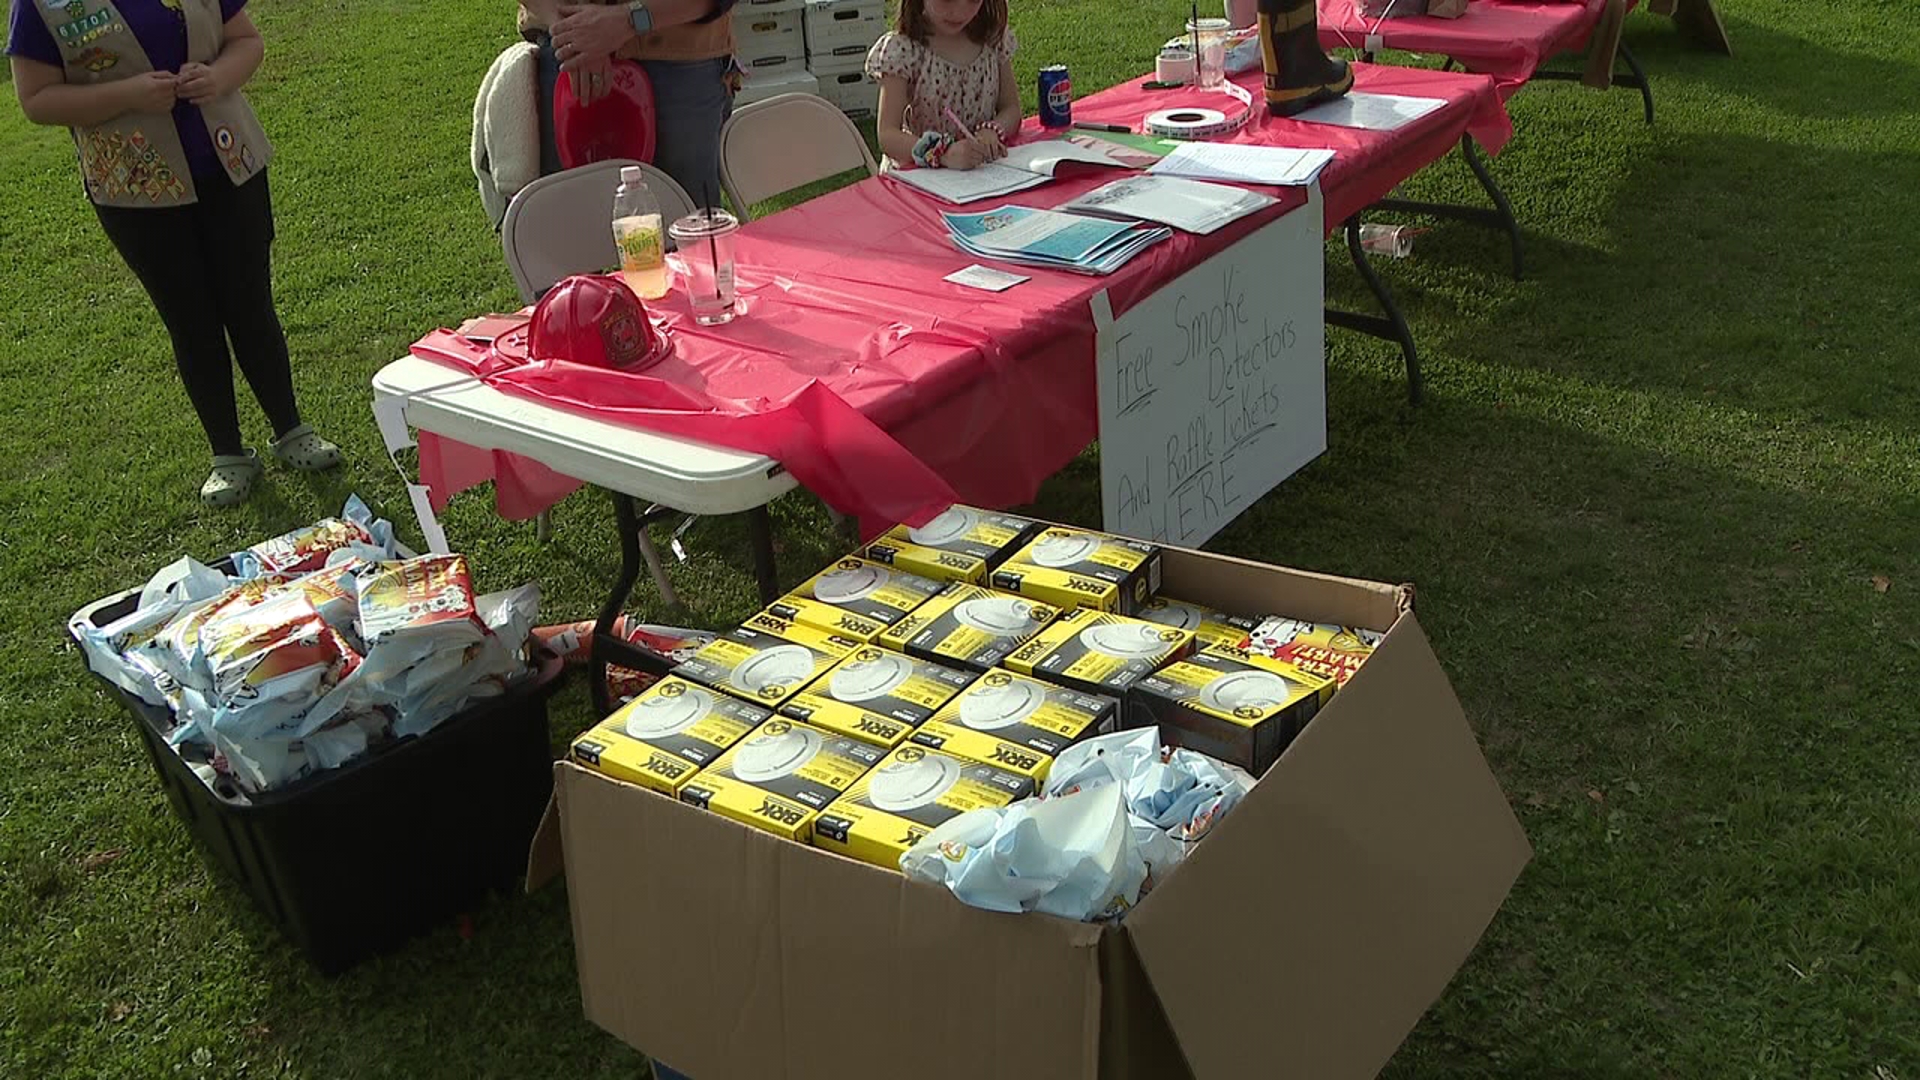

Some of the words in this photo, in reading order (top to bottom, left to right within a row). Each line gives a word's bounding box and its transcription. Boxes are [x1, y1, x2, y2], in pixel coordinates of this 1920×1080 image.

[59, 10, 109, 37] 61701
[1116, 333, 1153, 409] Free
[1208, 317, 1296, 402] Detectors
[1118, 455, 1151, 529] And
[1167, 413, 1214, 490] Raffle
[1151, 454, 1241, 544] HERE
[1063, 577, 1107, 595] BRK
[753, 615, 793, 632] BRK
[834, 616, 876, 636] BRK
[888, 614, 924, 638] BRK
[1014, 638, 1050, 662] BRK
[852, 717, 899, 739] BRK
[638, 756, 685, 780] BRK
[986, 746, 1039, 771] BRK
[752, 800, 804, 826] BRK
